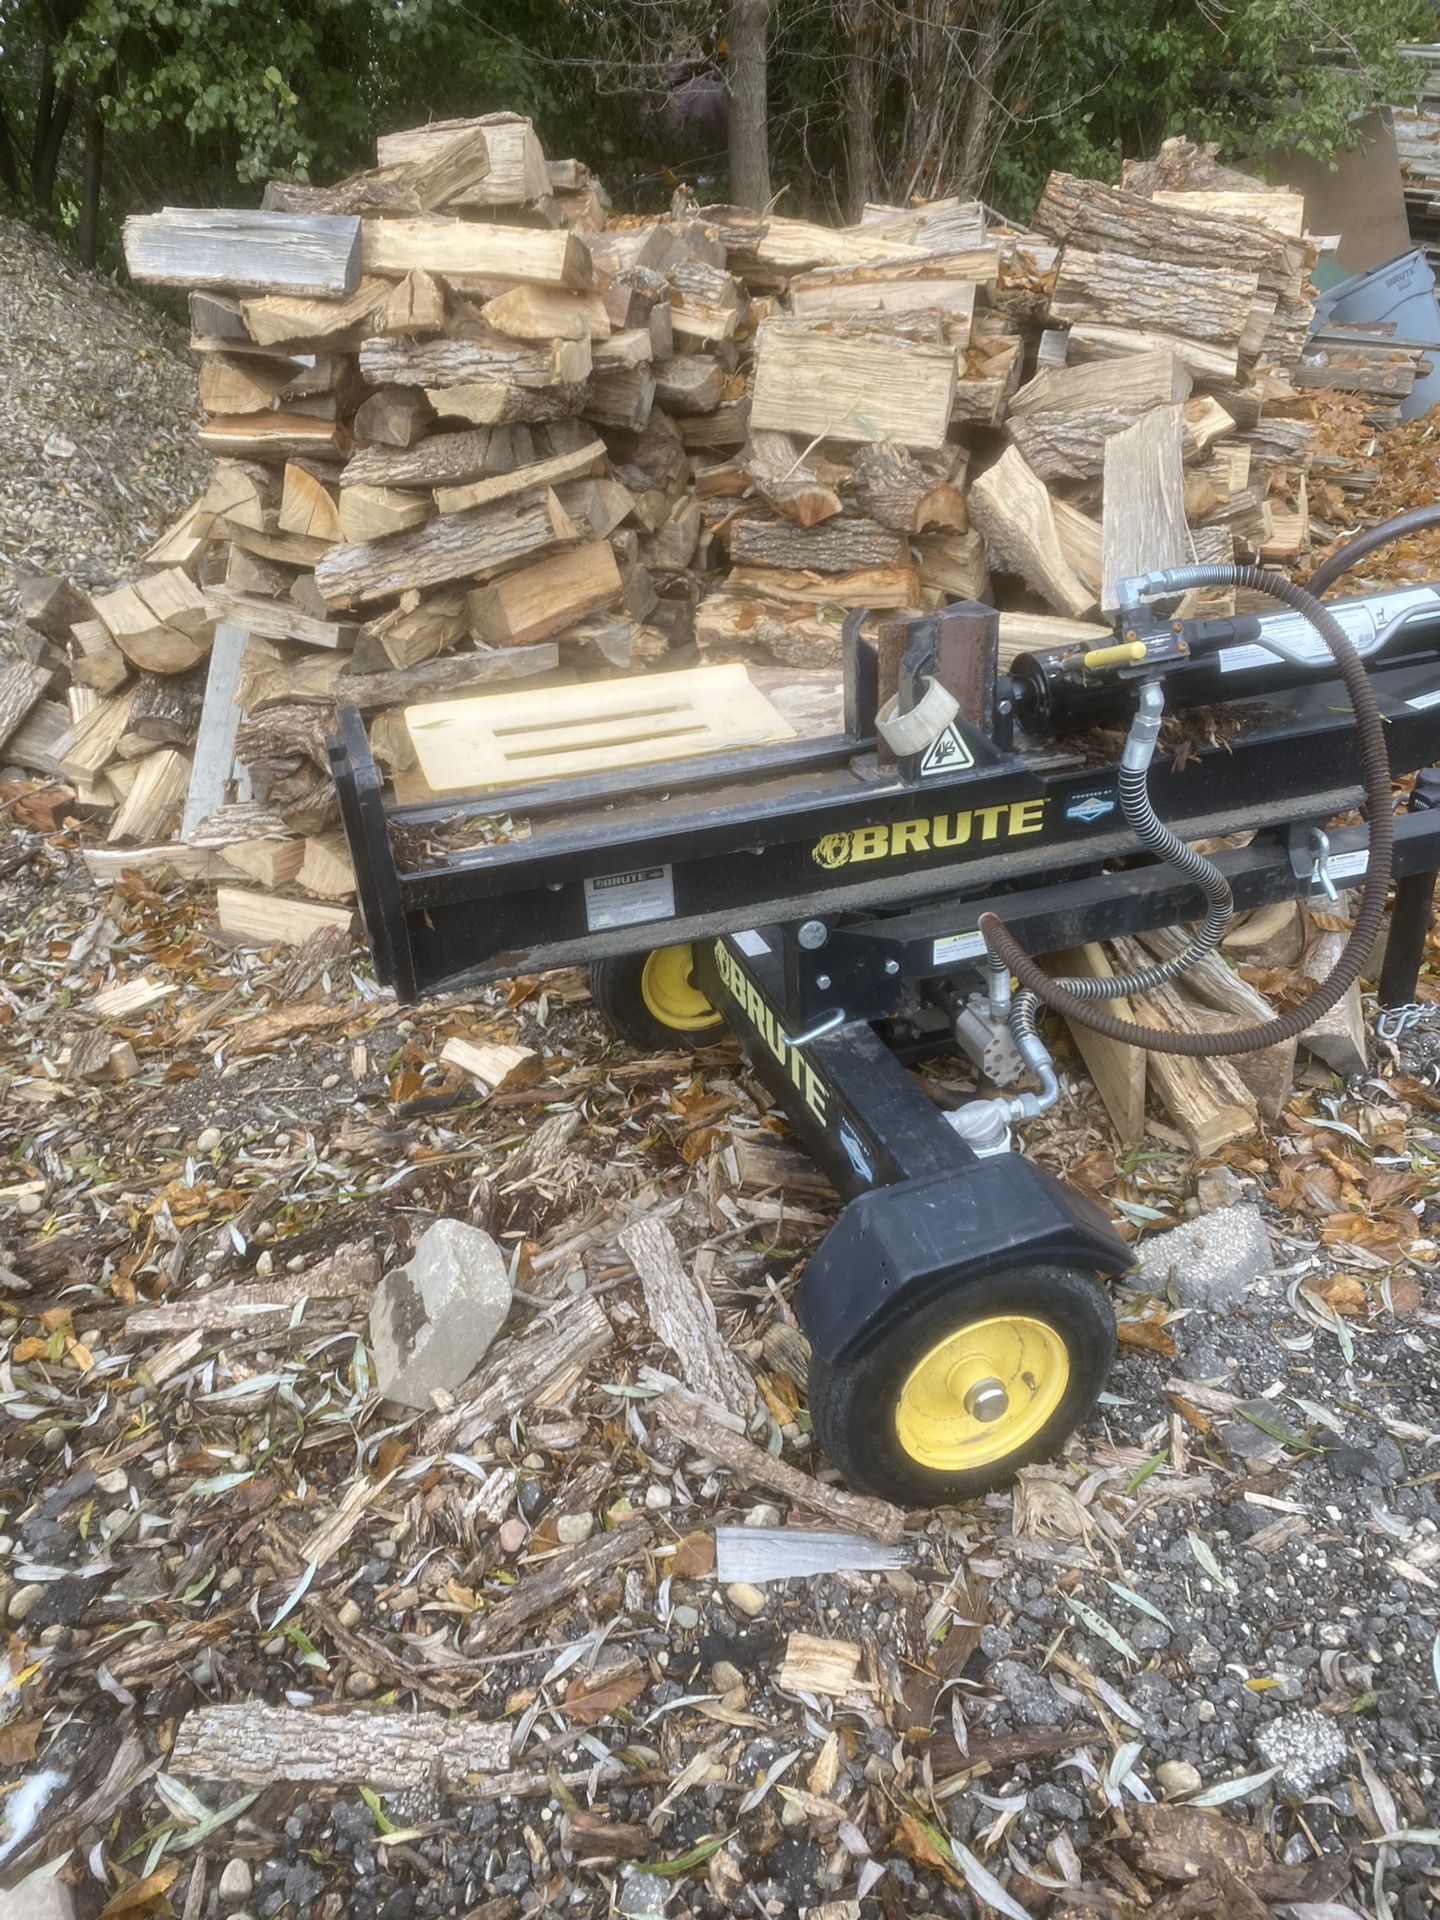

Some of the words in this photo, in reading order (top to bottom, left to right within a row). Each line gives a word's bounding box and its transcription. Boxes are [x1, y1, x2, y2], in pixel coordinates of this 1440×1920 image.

[850, 799, 1044, 863] BRUTE
[603, 872, 647, 887] BRUTE
[730, 954, 827, 1128] BRUTE
